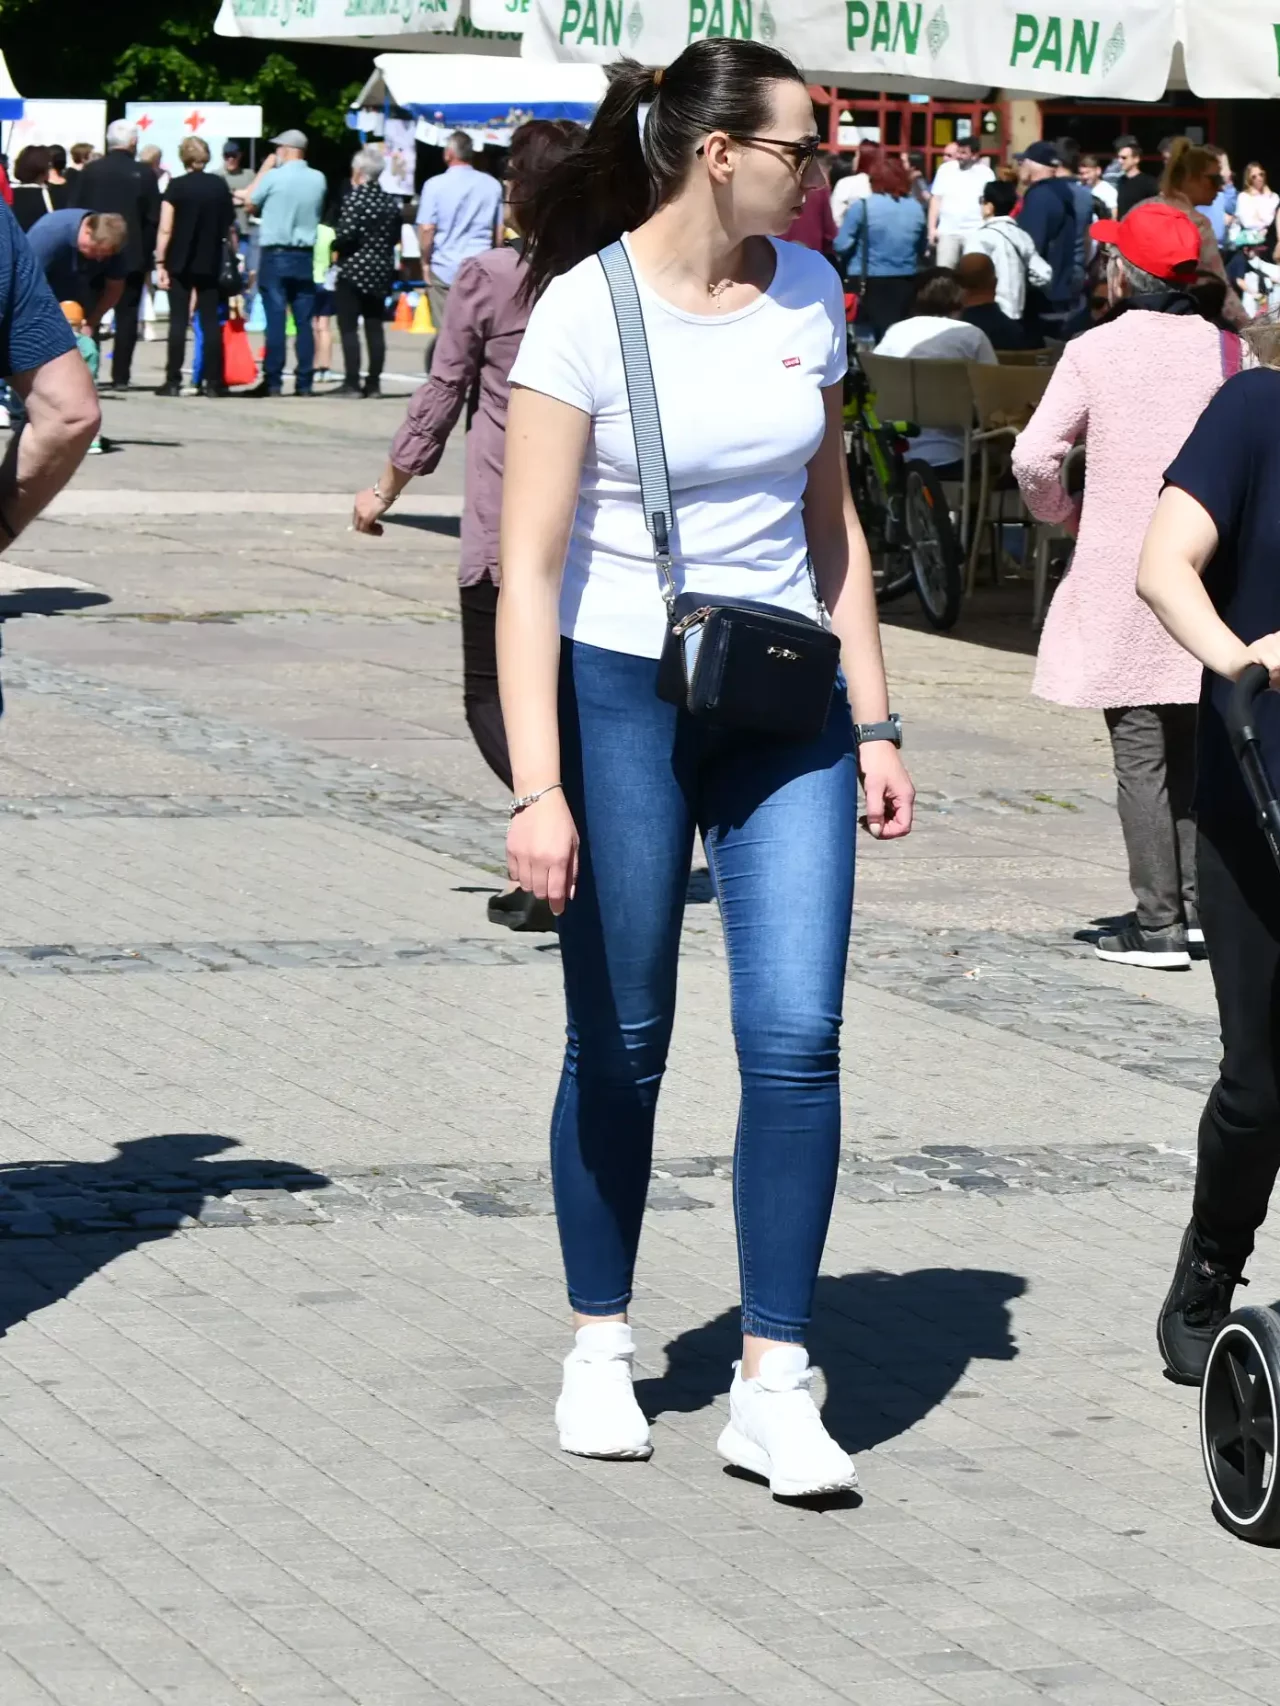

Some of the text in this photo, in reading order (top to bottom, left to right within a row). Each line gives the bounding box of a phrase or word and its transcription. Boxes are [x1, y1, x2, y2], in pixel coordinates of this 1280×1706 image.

[559, 0, 622, 46] PAN
[687, 0, 751, 45] PAN
[845, 0, 922, 56] PAN
[1010, 13, 1100, 75] PAN
